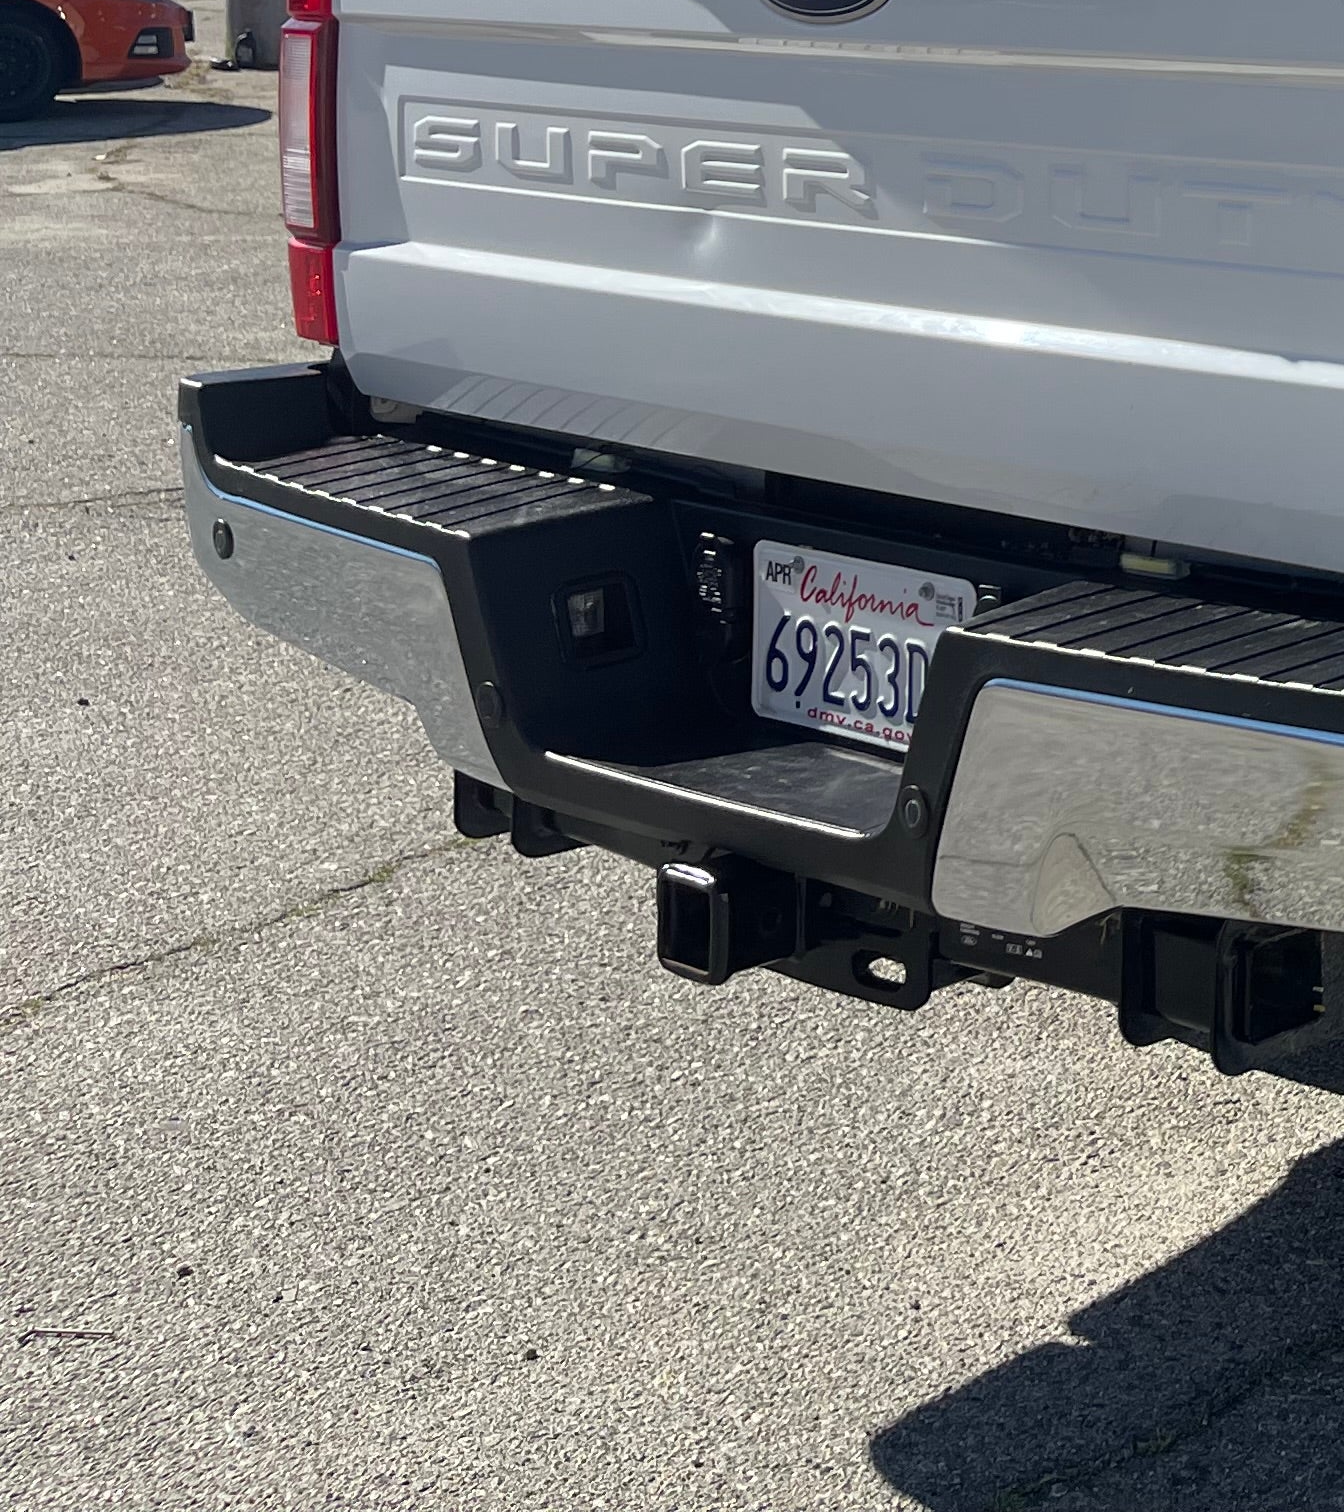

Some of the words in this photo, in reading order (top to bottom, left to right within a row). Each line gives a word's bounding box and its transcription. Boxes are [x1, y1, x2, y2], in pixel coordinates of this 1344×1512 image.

[413, 114, 878, 218] SUPER
[765, 561, 792, 585] APR
[800, 565, 935, 626] California
